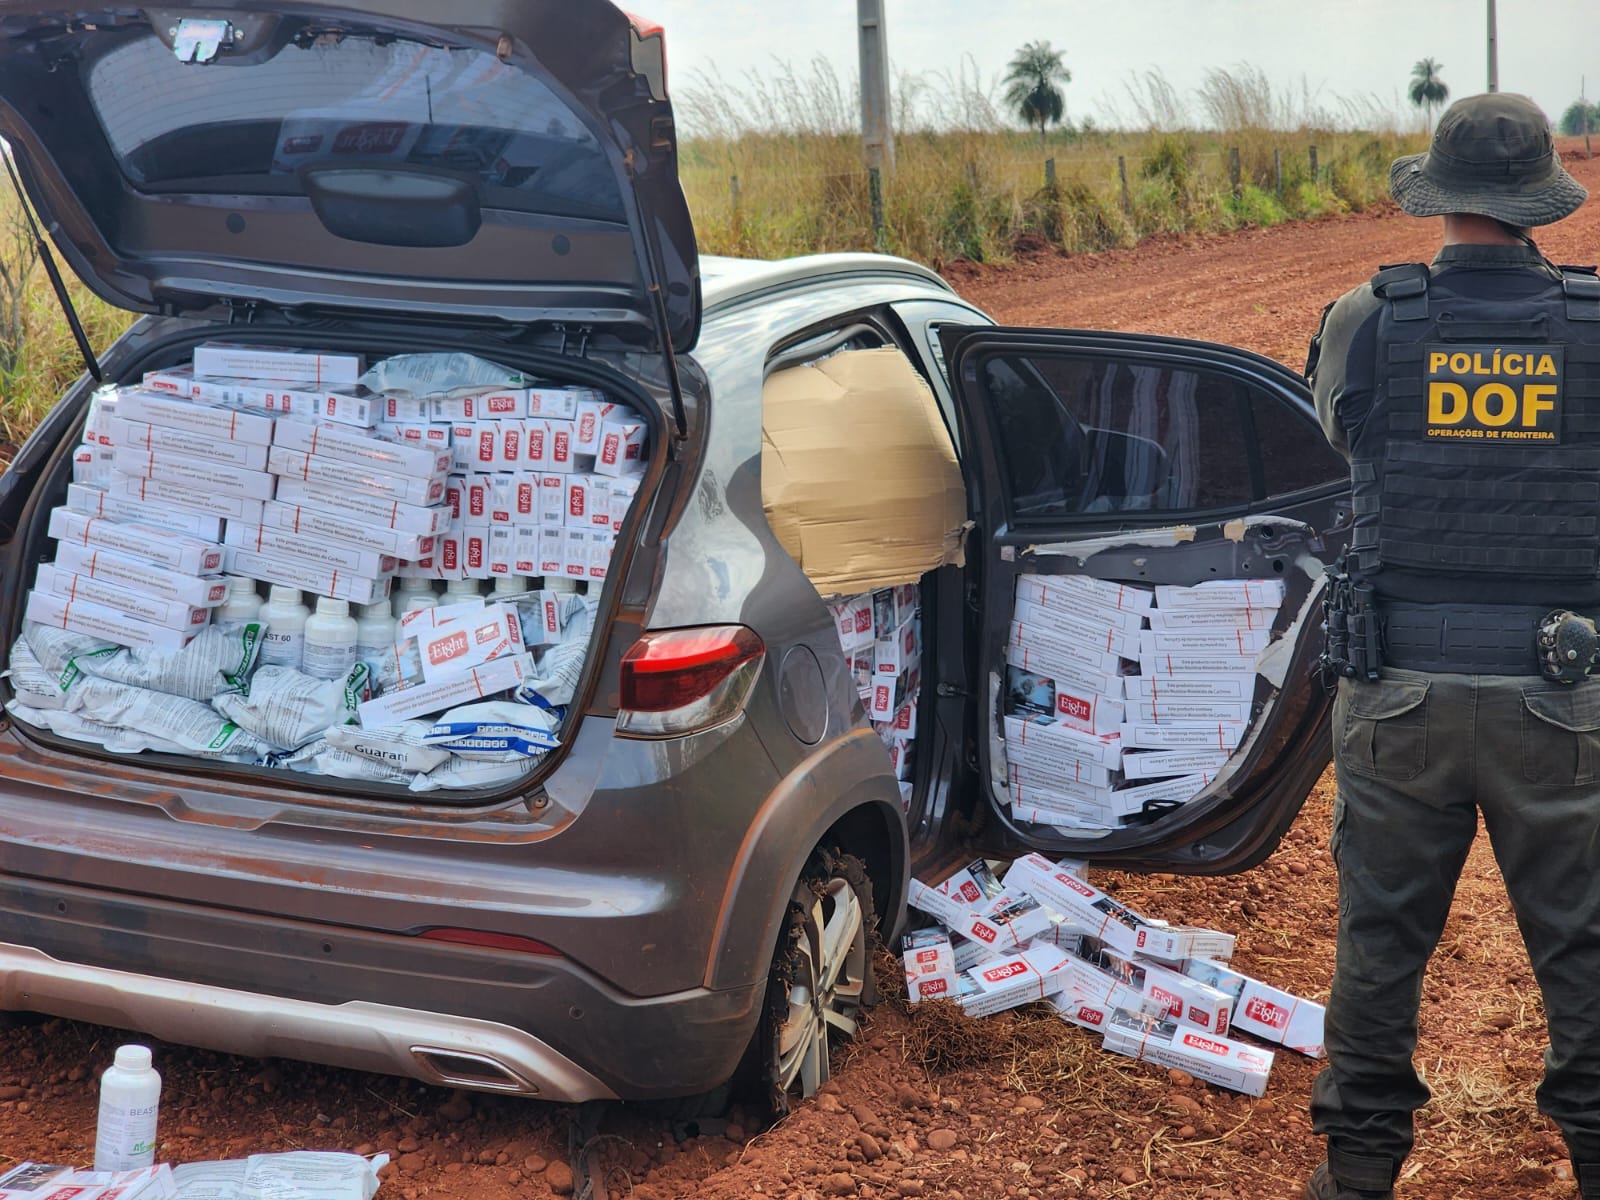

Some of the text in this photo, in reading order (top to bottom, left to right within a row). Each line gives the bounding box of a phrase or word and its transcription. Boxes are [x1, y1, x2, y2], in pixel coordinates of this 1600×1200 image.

[1429, 348, 1557, 376] POLÍCIA
[490, 398, 513, 410] Eight
[1428, 382, 1557, 427] DOF
[1428, 429, 1483, 438] OPERAÇÕES
[1501, 431, 1555, 440] FRONTEIRA
[445, 543, 454, 566] Eight
[471, 541, 480, 565] Eight
[264, 633, 279, 641] AST
[432, 636, 465, 659] Eight
[1061, 697, 1087, 715] Eight
[974, 923, 993, 939] Eight
[989, 964, 1023, 979] Eight
[921, 982, 944, 993] Eight
[1081, 1009, 1101, 1021] Eight
[1251, 1001, 1284, 1022] Eight
[1189, 1036, 1224, 1054] Eight
[130, 1104, 156, 1116] BEAST
